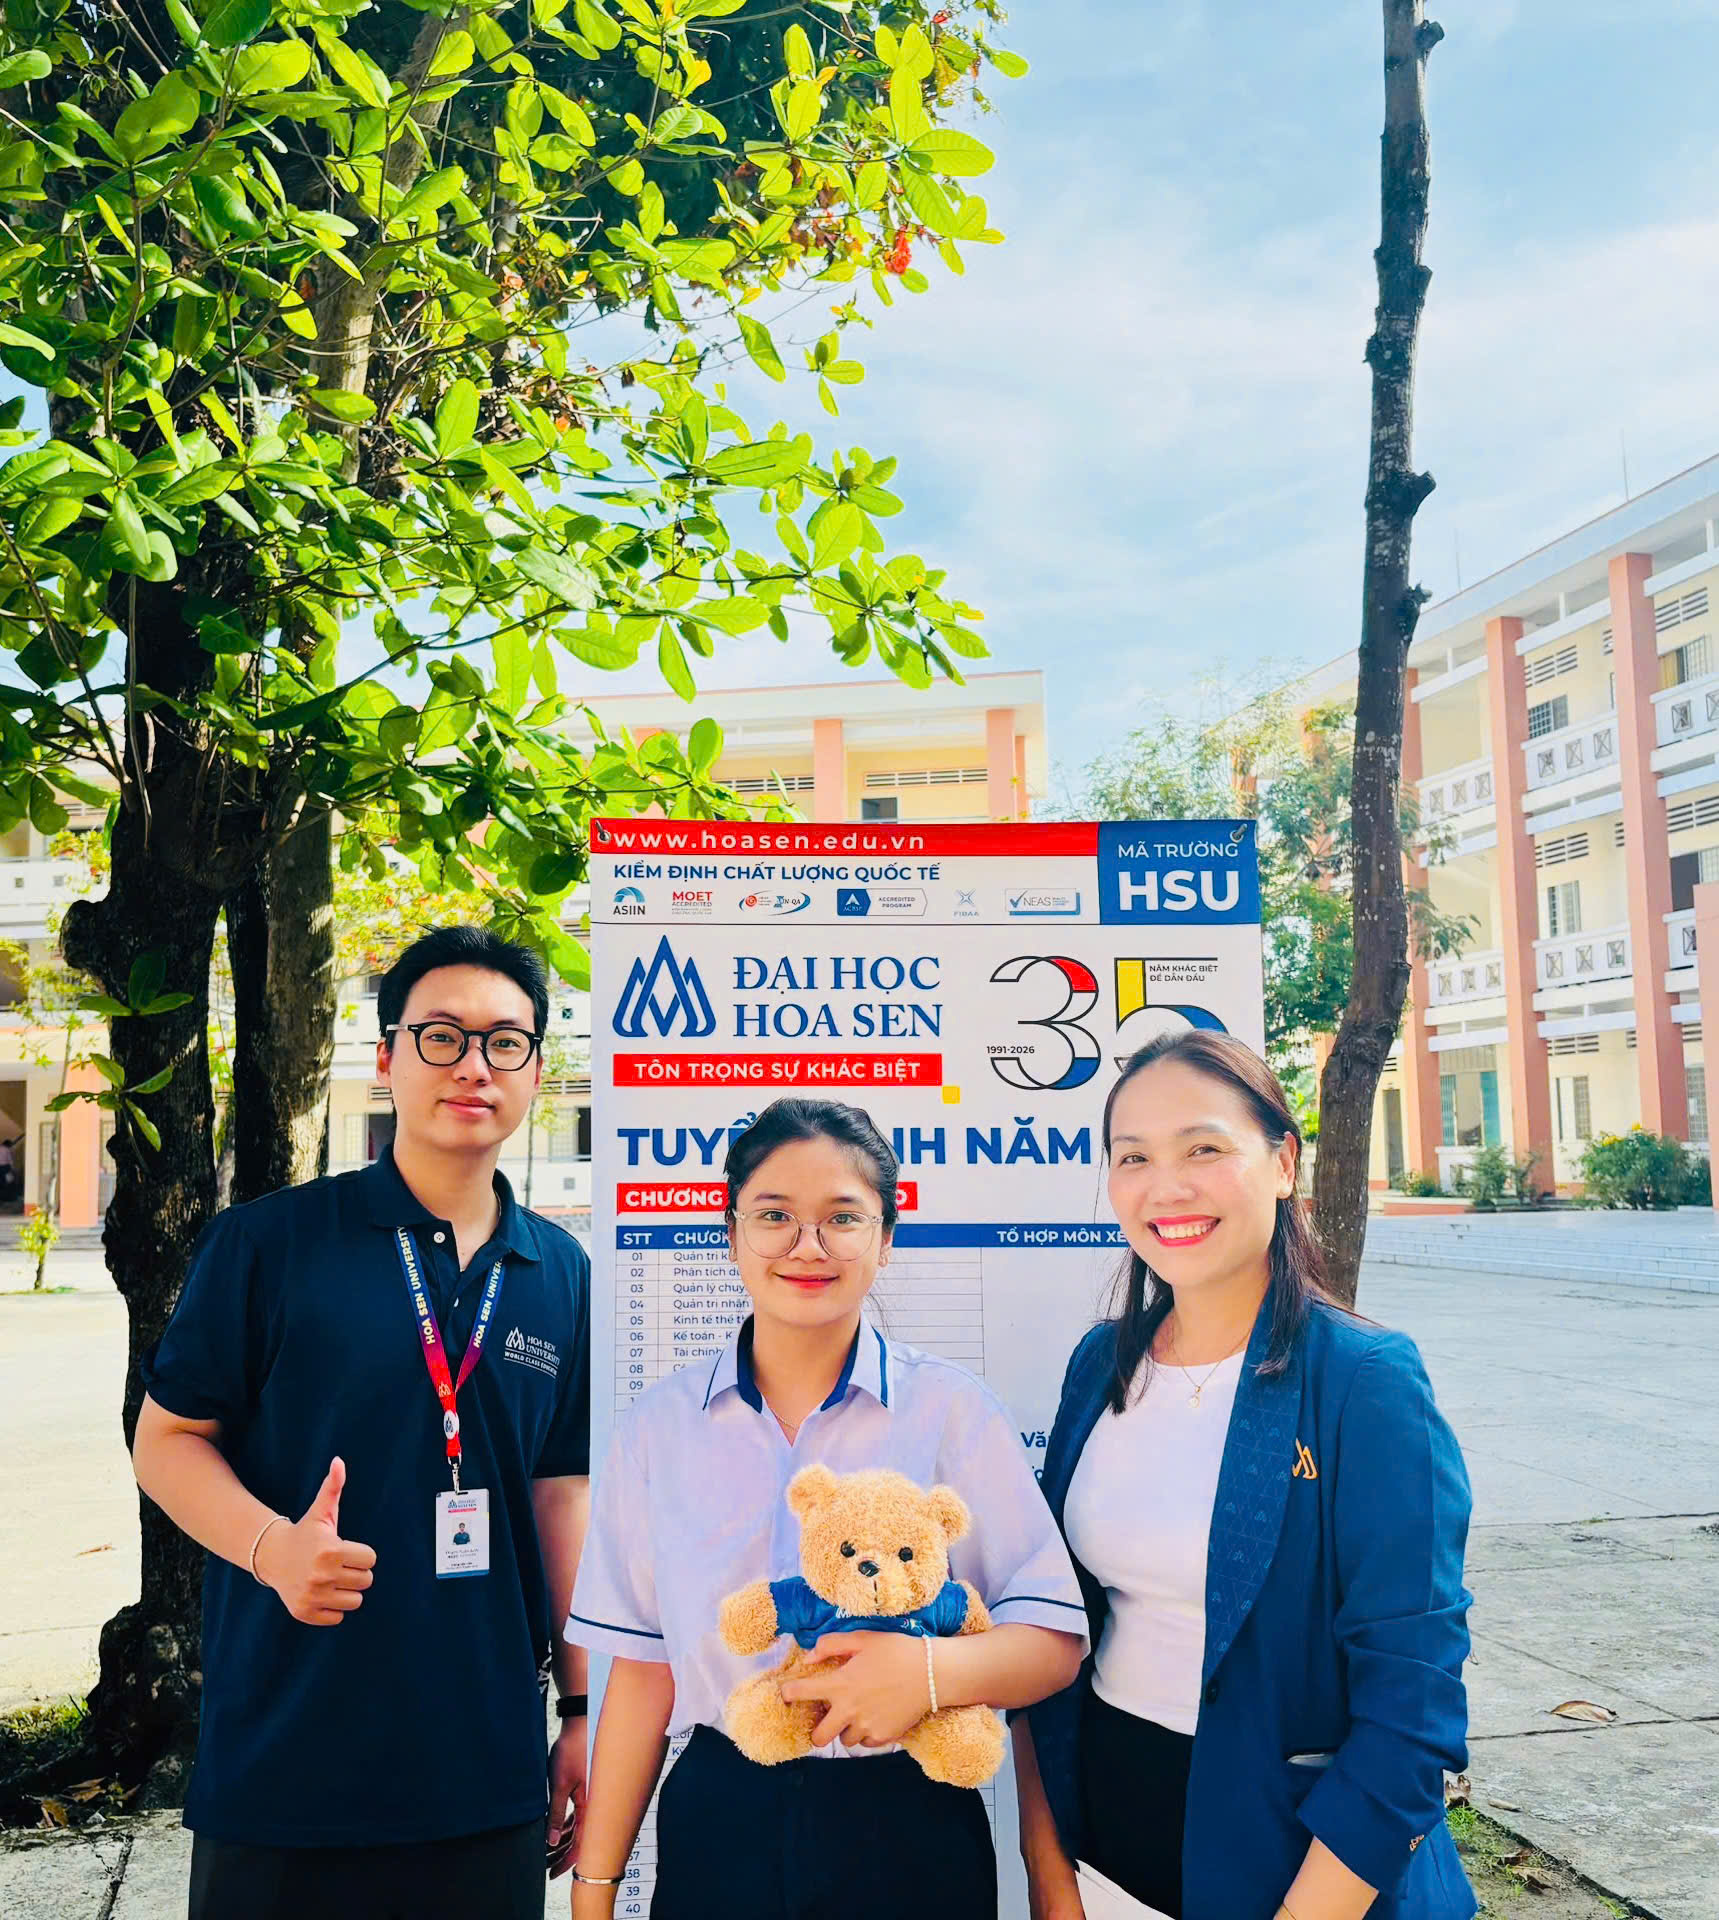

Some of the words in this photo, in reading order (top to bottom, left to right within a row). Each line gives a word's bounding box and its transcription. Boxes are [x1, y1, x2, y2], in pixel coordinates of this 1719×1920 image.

[613, 831, 925, 850] www.hoasen.edu.vn
[1118, 840, 1149, 858] MÃ
[1153, 840, 1239, 858] TRƯỜNG
[614, 859, 662, 880] KIỂM
[667, 865, 718, 883] ĐỊNH
[723, 861, 775, 881] CHẤT
[781, 864, 849, 884] LƯỢNG
[856, 862, 911, 883] QUỐC
[917, 862, 941, 881] TẾ
[672, 891, 712, 902] MOET
[1118, 869, 1240, 911] HSU
[1023, 896, 1051, 907] NEAS
[613, 905, 645, 916] ASIIN
[733, 956, 818, 995] ĐẠI
[829, 956, 941, 995] HỌC
[733, 1003, 843, 1038] HOA
[852, 1003, 943, 1038] SEN
[986, 1045, 1035, 1055] 1991-2026
[635, 1062, 680, 1079] TÔN
[687, 1063, 763, 1082] TRỌNG
[770, 1060, 800, 1082] SỰ
[807, 1059, 865, 1079] KHÁC
[874, 1061, 920, 1082] BIỆT
[966, 1116, 1091, 1165] NĂM
[625, 1187, 723, 1207] CHƯƠNG
[623, 1232, 652, 1245] STT
[996, 1225, 1019, 1243] TỔ
[1023, 1228, 1059, 1246] HỢP
[1063, 1227, 1101, 1243] MÔN
[397, 1226, 422, 1290] UNIVERSITY
[631, 1252, 643, 1261] 01
[486, 1257, 503, 1299] UNIVER
[630, 1268, 644, 1277] 02
[630, 1284, 644, 1293] 03
[414, 1292, 429, 1317] SEN
[480, 1299, 493, 1322] SEN
[629, 1300, 644, 1309] 04
[630, 1316, 644, 1326] 05
[673, 1315, 698, 1325] Kinh
[421, 1317, 436, 1345] HOA
[473, 1324, 487, 1348] HOA
[629, 1332, 644, 1341] 06
[527, 1335, 543, 1348] HOA
[504, 1351, 525, 1362] WORLD
[525, 1356, 541, 1367] CLASS
[629, 1348, 644, 1358] 07
[629, 1364, 644, 1374] 08
[629, 1380, 644, 1390] 09
[626, 1868, 641, 1879] 38
[626, 1886, 641, 1897] 39
[625, 1903, 641, 1914] 40
